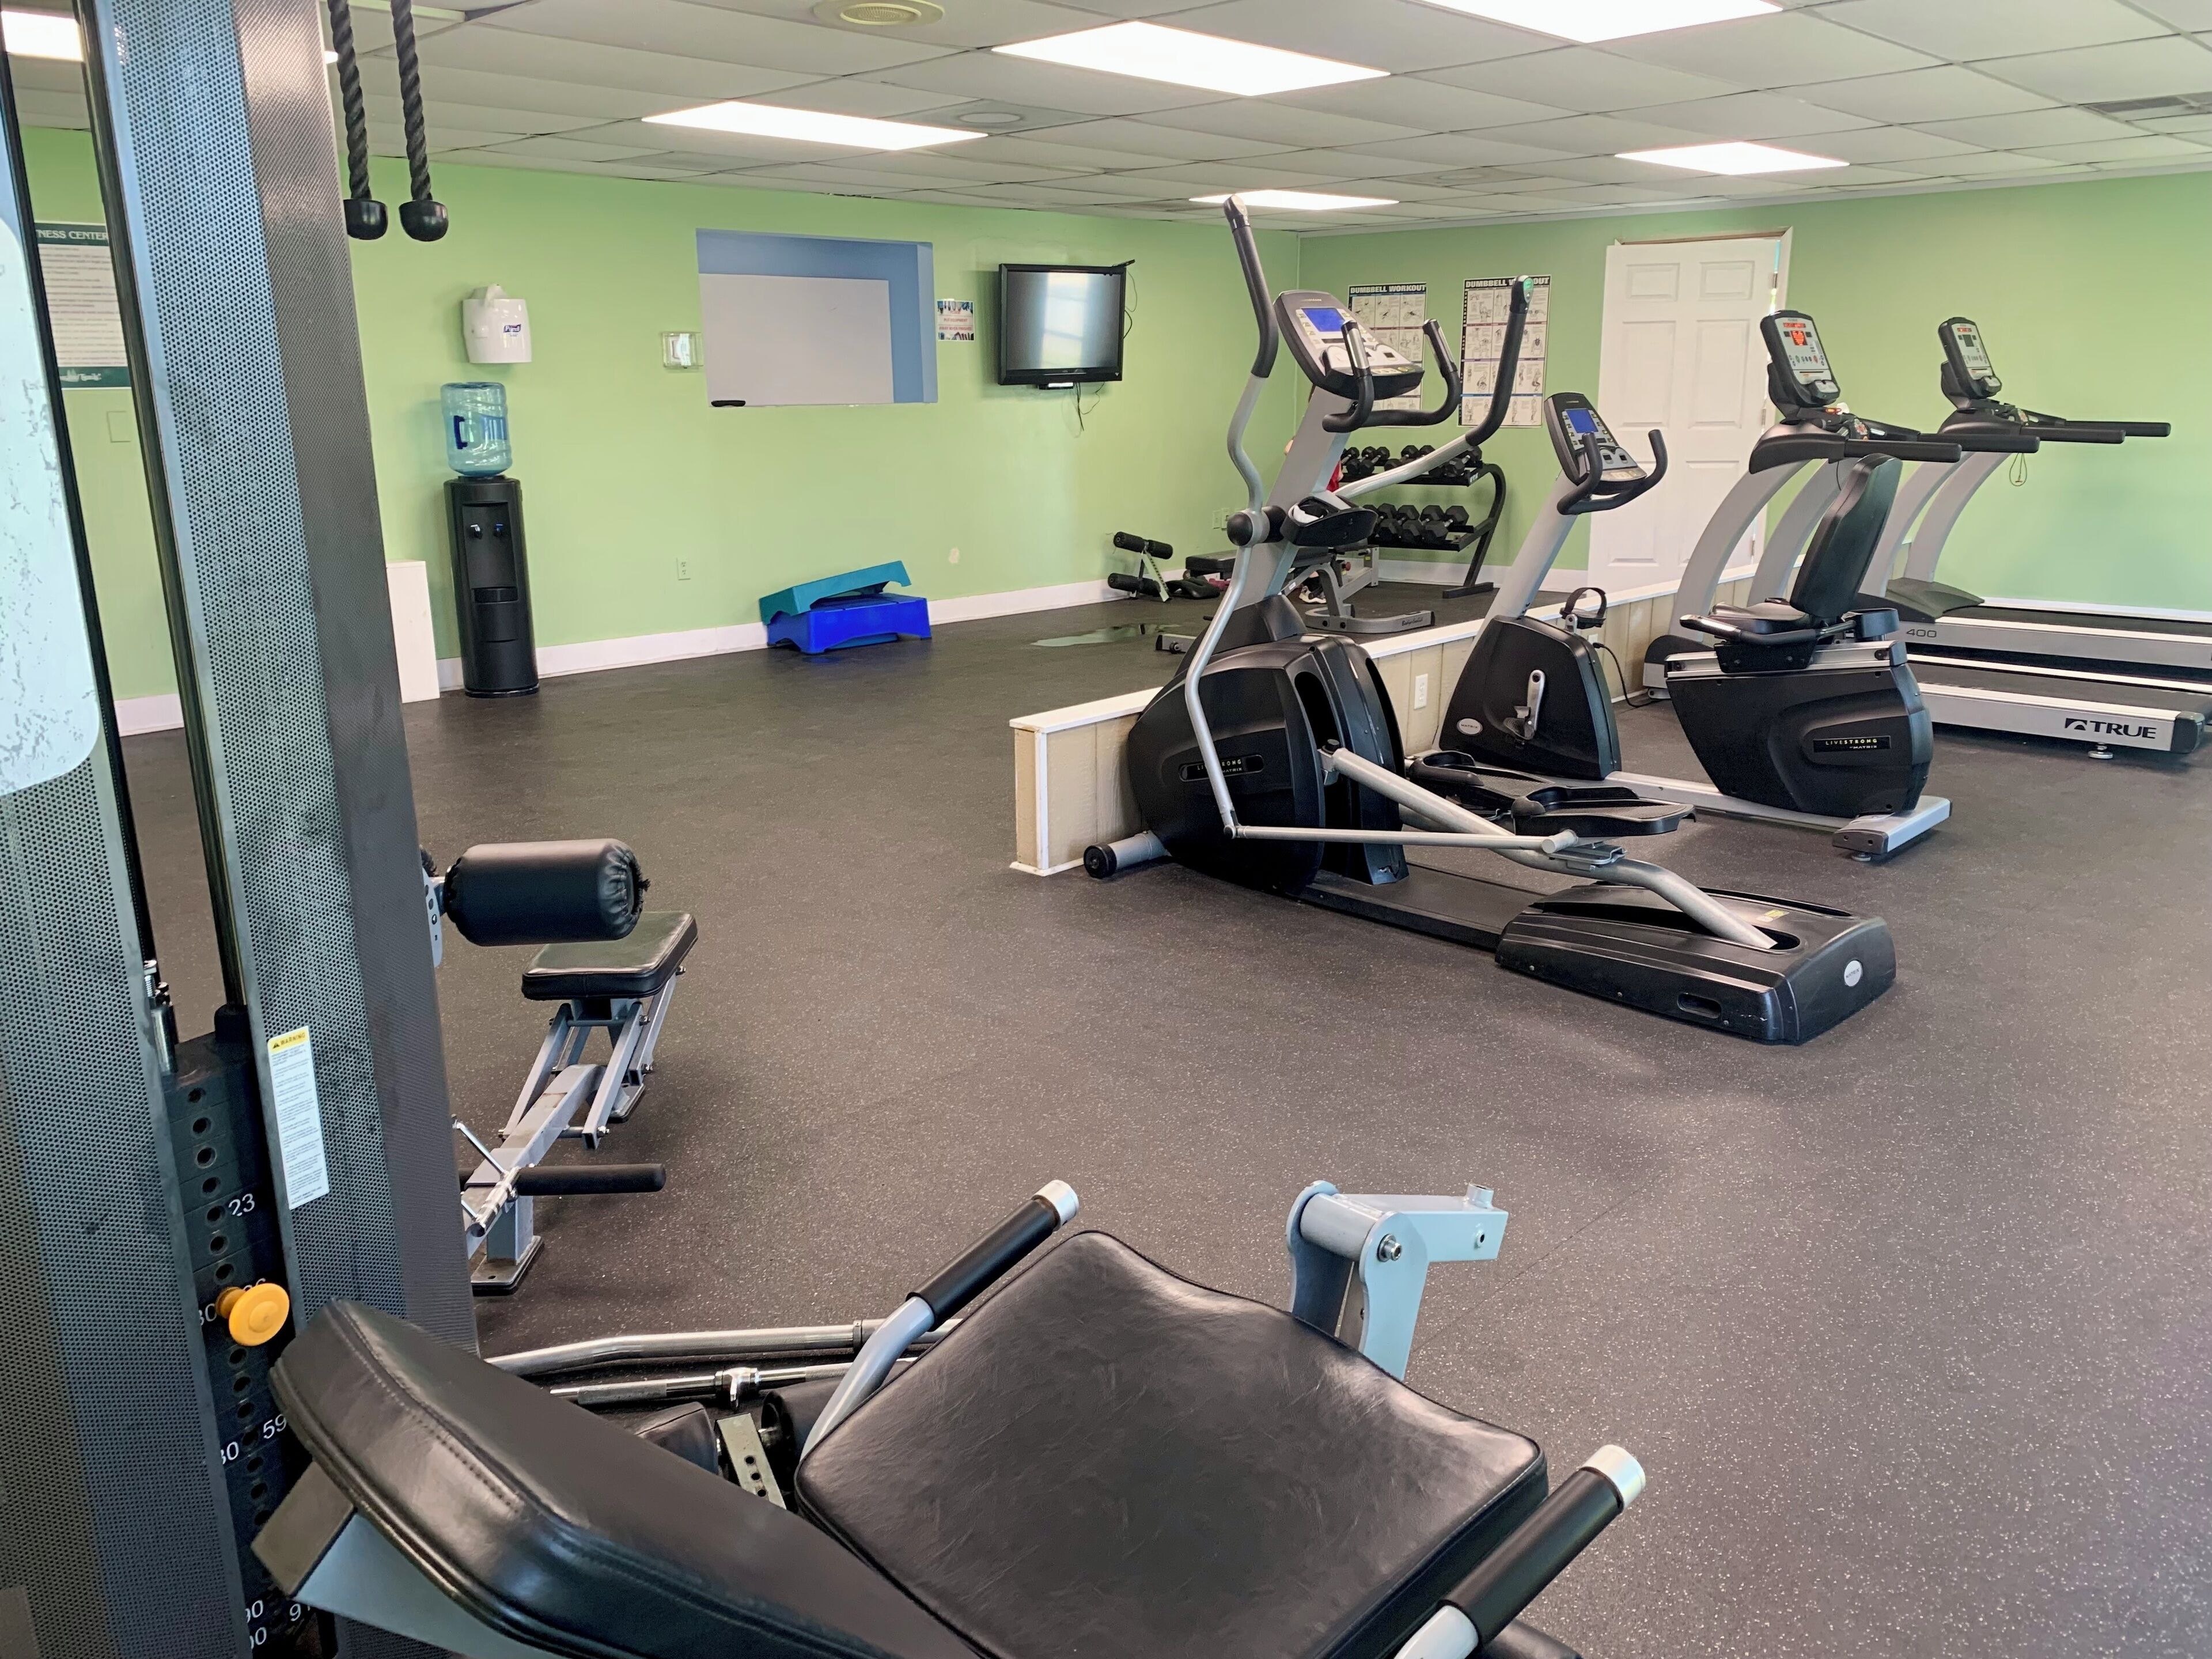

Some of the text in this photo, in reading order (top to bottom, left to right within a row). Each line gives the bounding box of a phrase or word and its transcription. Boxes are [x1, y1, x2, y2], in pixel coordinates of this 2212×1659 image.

[68, 231, 108, 240] CENTER
[1465, 279, 1508, 288] DUMBBELL
[1350, 286, 1387, 294] DUMBBELL
[1906, 628, 1937, 638] 400
[2090, 720, 2157, 739] TRUE
[1197, 759, 1241, 770] LIRONG
[281, 1032, 305, 1045] WARNING
[228, 1194, 255, 1217] 23
[263, 1414, 287, 1439] 59
